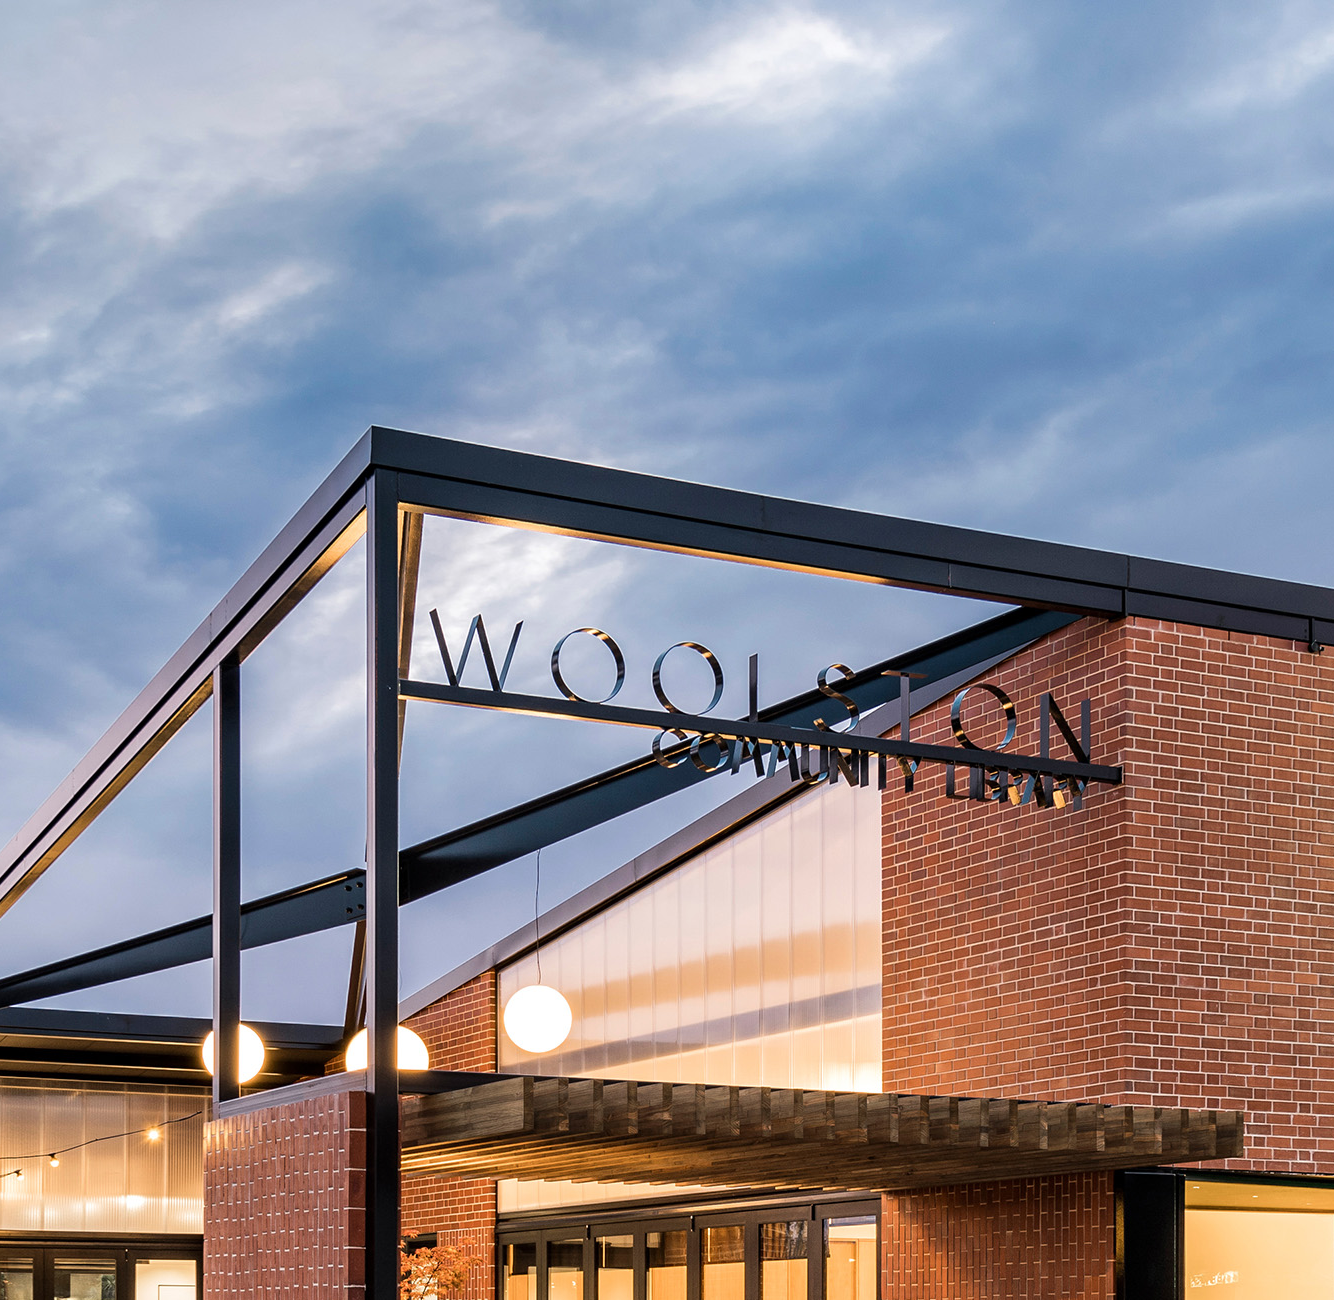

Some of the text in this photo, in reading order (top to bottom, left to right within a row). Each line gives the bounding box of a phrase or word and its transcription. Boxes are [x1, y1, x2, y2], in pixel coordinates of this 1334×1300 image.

[429, 608, 1091, 765] WOOLSTON
[652, 728, 1090, 812] COMMUNITY LIBRARY
